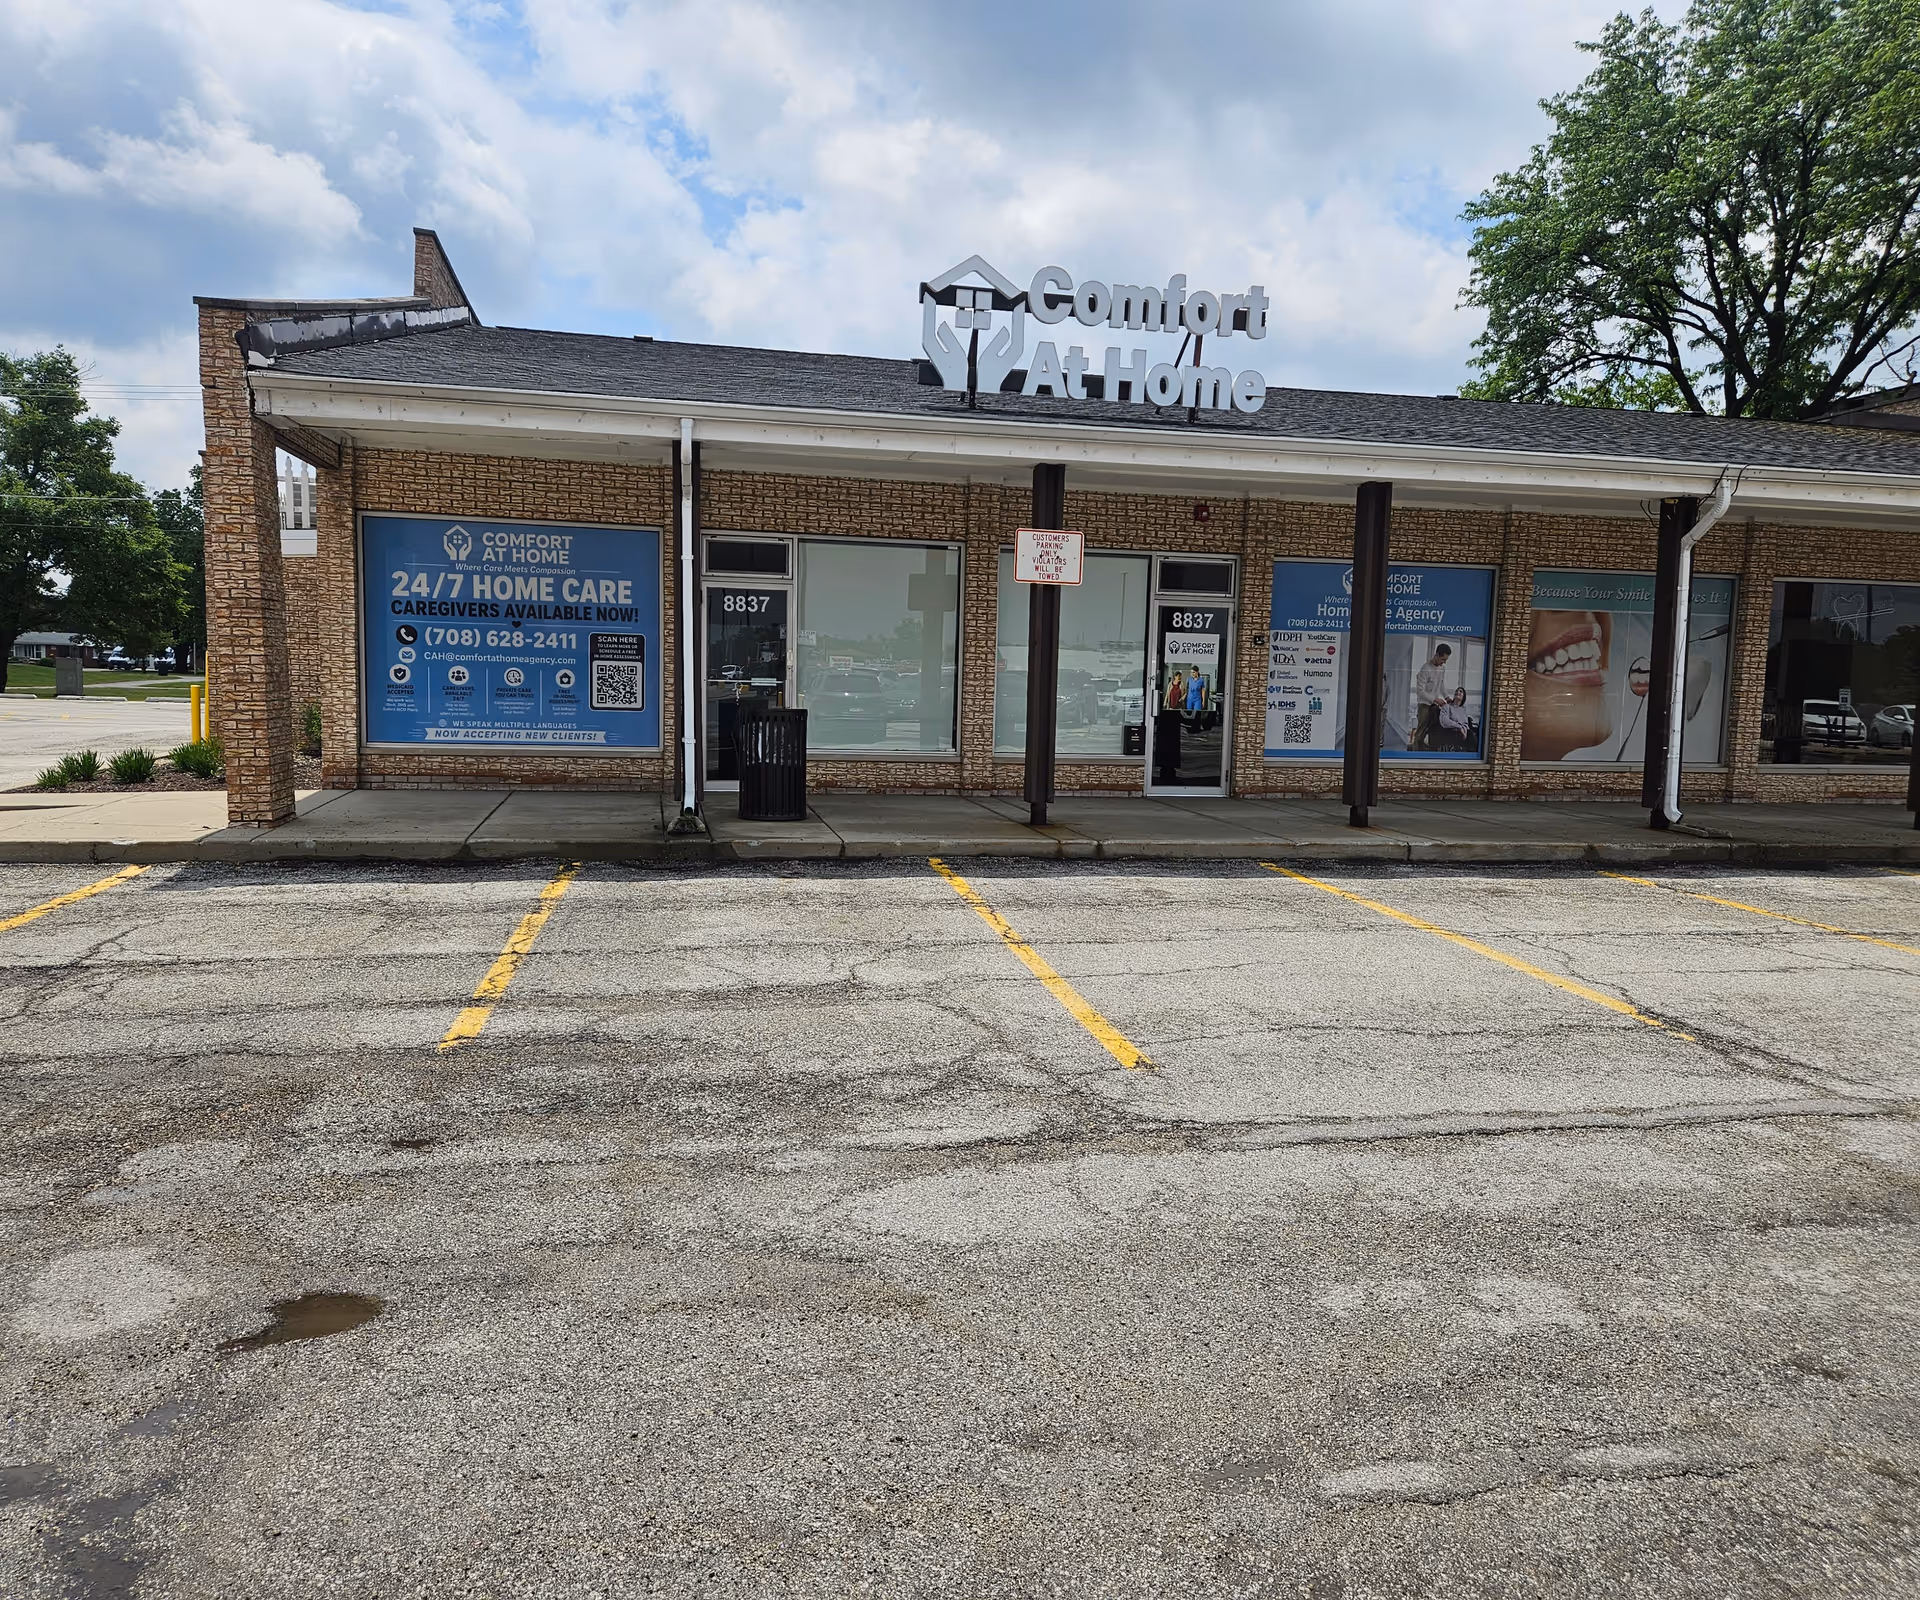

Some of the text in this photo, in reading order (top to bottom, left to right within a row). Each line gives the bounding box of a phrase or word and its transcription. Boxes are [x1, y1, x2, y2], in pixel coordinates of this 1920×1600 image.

[1028, 265, 1269, 340] Comfort
[1020, 341, 1267, 414] At Home
[482, 532, 573, 549] COMFORT
[1032, 533, 1070, 543] CUSTOMERS
[1036, 541, 1064, 550] PARKING
[482, 547, 569, 565] AT HOME
[1040, 549, 1058, 557] ONLY
[1032, 556, 1067, 566] VIOLATORS
[455, 563, 576, 576] Where Care Meets Compassion
[1034, 565, 1063, 573] WILL BE
[1038, 572, 1060, 581] TOWED
[1387, 573, 1423, 584] MFORT
[391, 570, 633, 605] 24/7 HOME CARE
[1532, 584, 1581, 599] Because
[1583, 586, 1614, 600] Your
[1616, 587, 1650, 601] Smile
[723, 595, 770, 613] 8837
[1324, 595, 1349, 604] Where
[1393, 597, 1437, 608] Compassion
[390, 599, 639, 623] CAREGIVERS AVAILABLE NOW!
[1317, 603, 1351, 617] Hom
[1395, 606, 1445, 623] Agency
[1172, 611, 1214, 629] 8837
[1287, 618, 1308, 628] (708)
[1309, 619, 1344, 628] 628-2411
[424, 626, 577, 649] (708) 628-2411
[619, 636, 638, 644] HERE
[1279, 632, 1337, 642] IDPH YouthCare
[424, 651, 577, 666] CAH@comfortathomeagency.com
[1303, 669, 1333, 677] Humana
[1278, 700, 1296, 708] IDHS
[452, 720, 577, 730] WE SPEAK MULTIPLE LANGUAGES
[434, 729, 597, 741] NOW ACCEPTING NEW CLIENTS!
